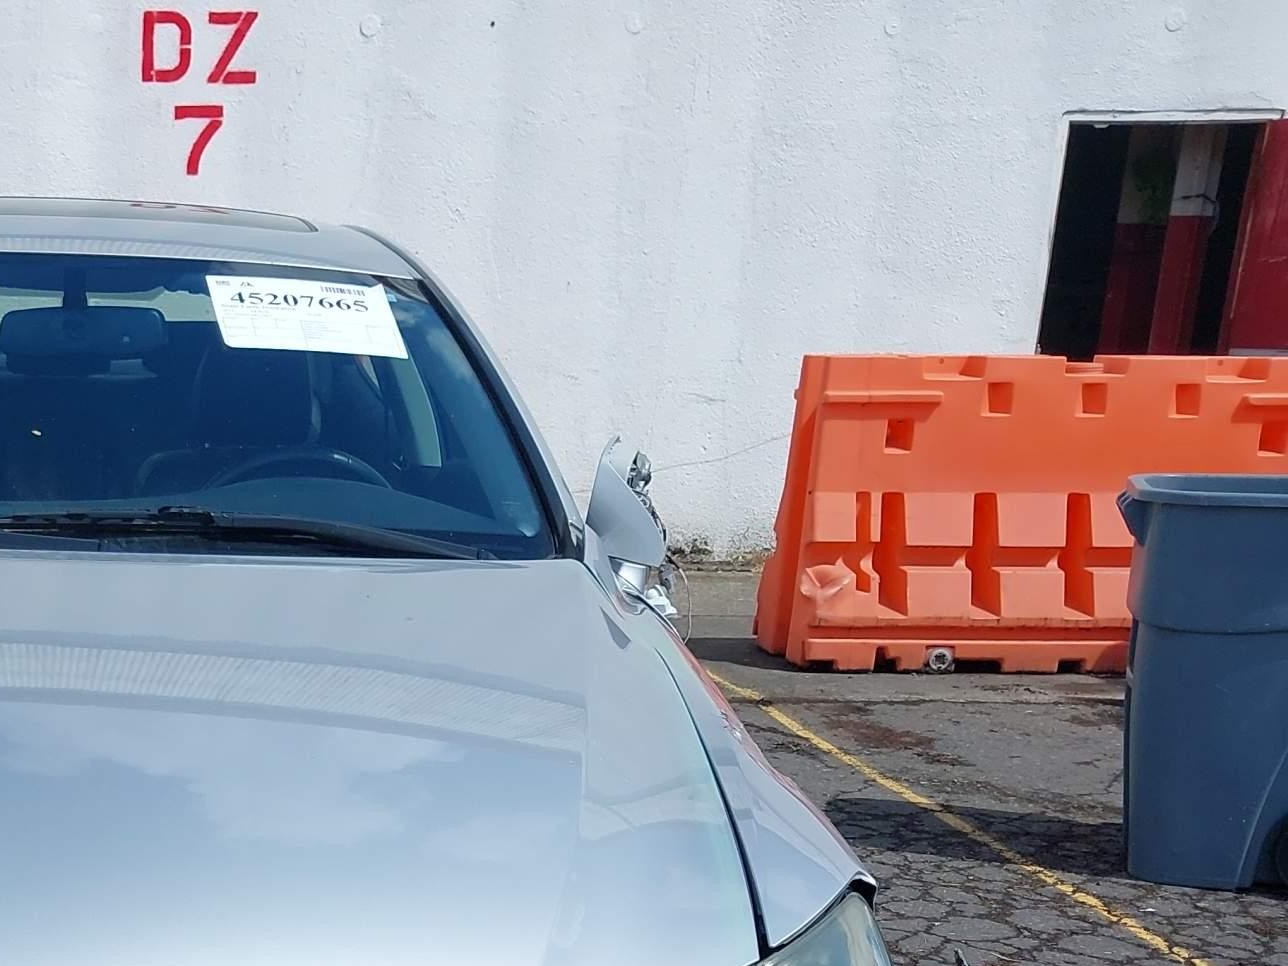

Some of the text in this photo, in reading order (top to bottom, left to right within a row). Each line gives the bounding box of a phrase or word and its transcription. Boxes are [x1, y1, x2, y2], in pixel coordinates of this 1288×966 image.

[140, 9, 259, 85] DZ
[172, 103, 225, 176] 7
[229, 291, 370, 312] 45207665
